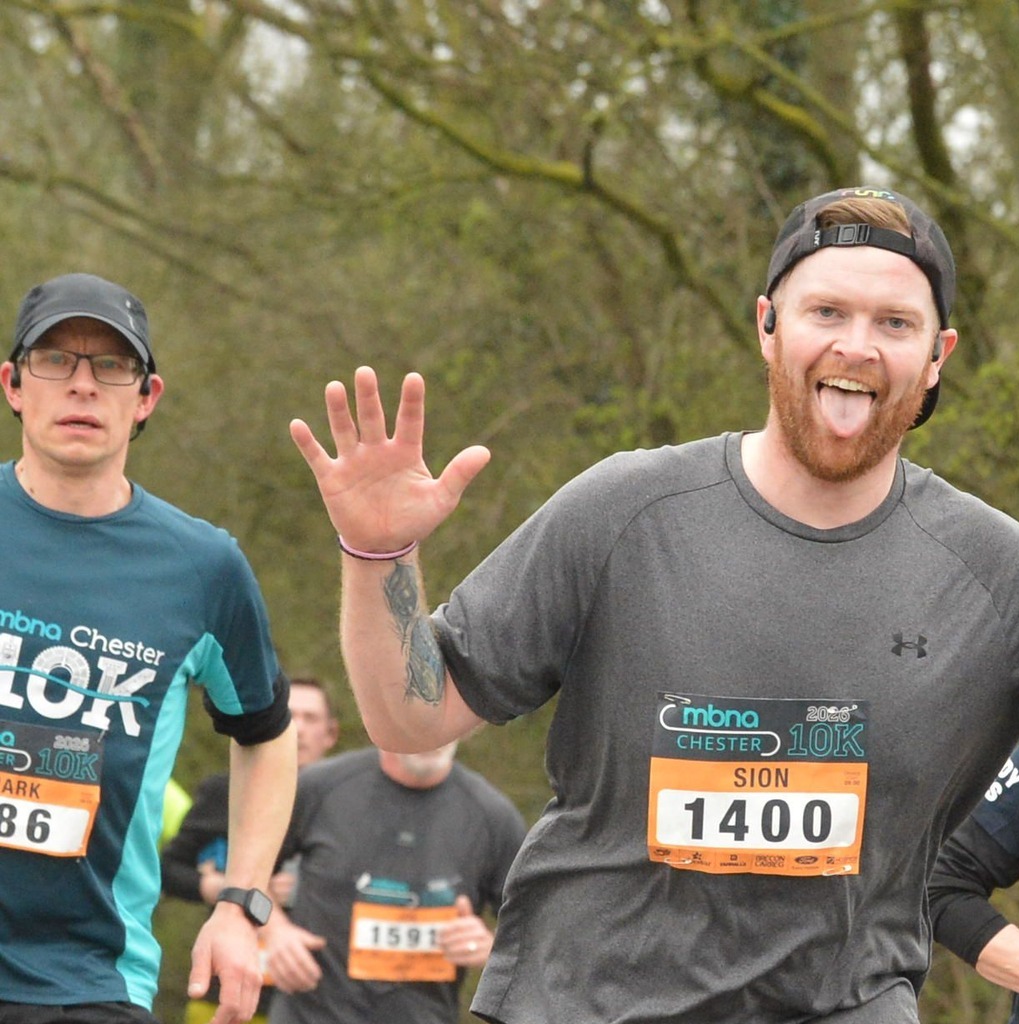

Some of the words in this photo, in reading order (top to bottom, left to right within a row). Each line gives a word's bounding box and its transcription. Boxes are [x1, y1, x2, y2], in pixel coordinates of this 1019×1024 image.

[70, 625, 165, 666] Chester
[0, 632, 156, 737] 10K
[683, 704, 760, 729] mbna
[677, 734, 762, 752] CHESTER
[787, 722, 865, 757] 10K
[35, 747, 99, 780] 10K
[733, 767, 789, 788] SION
[2, 779, 41, 799] ARK
[0, 803, 51, 844] 86
[684, 797, 832, 843] 1400
[371, 925, 437, 946] 1591
